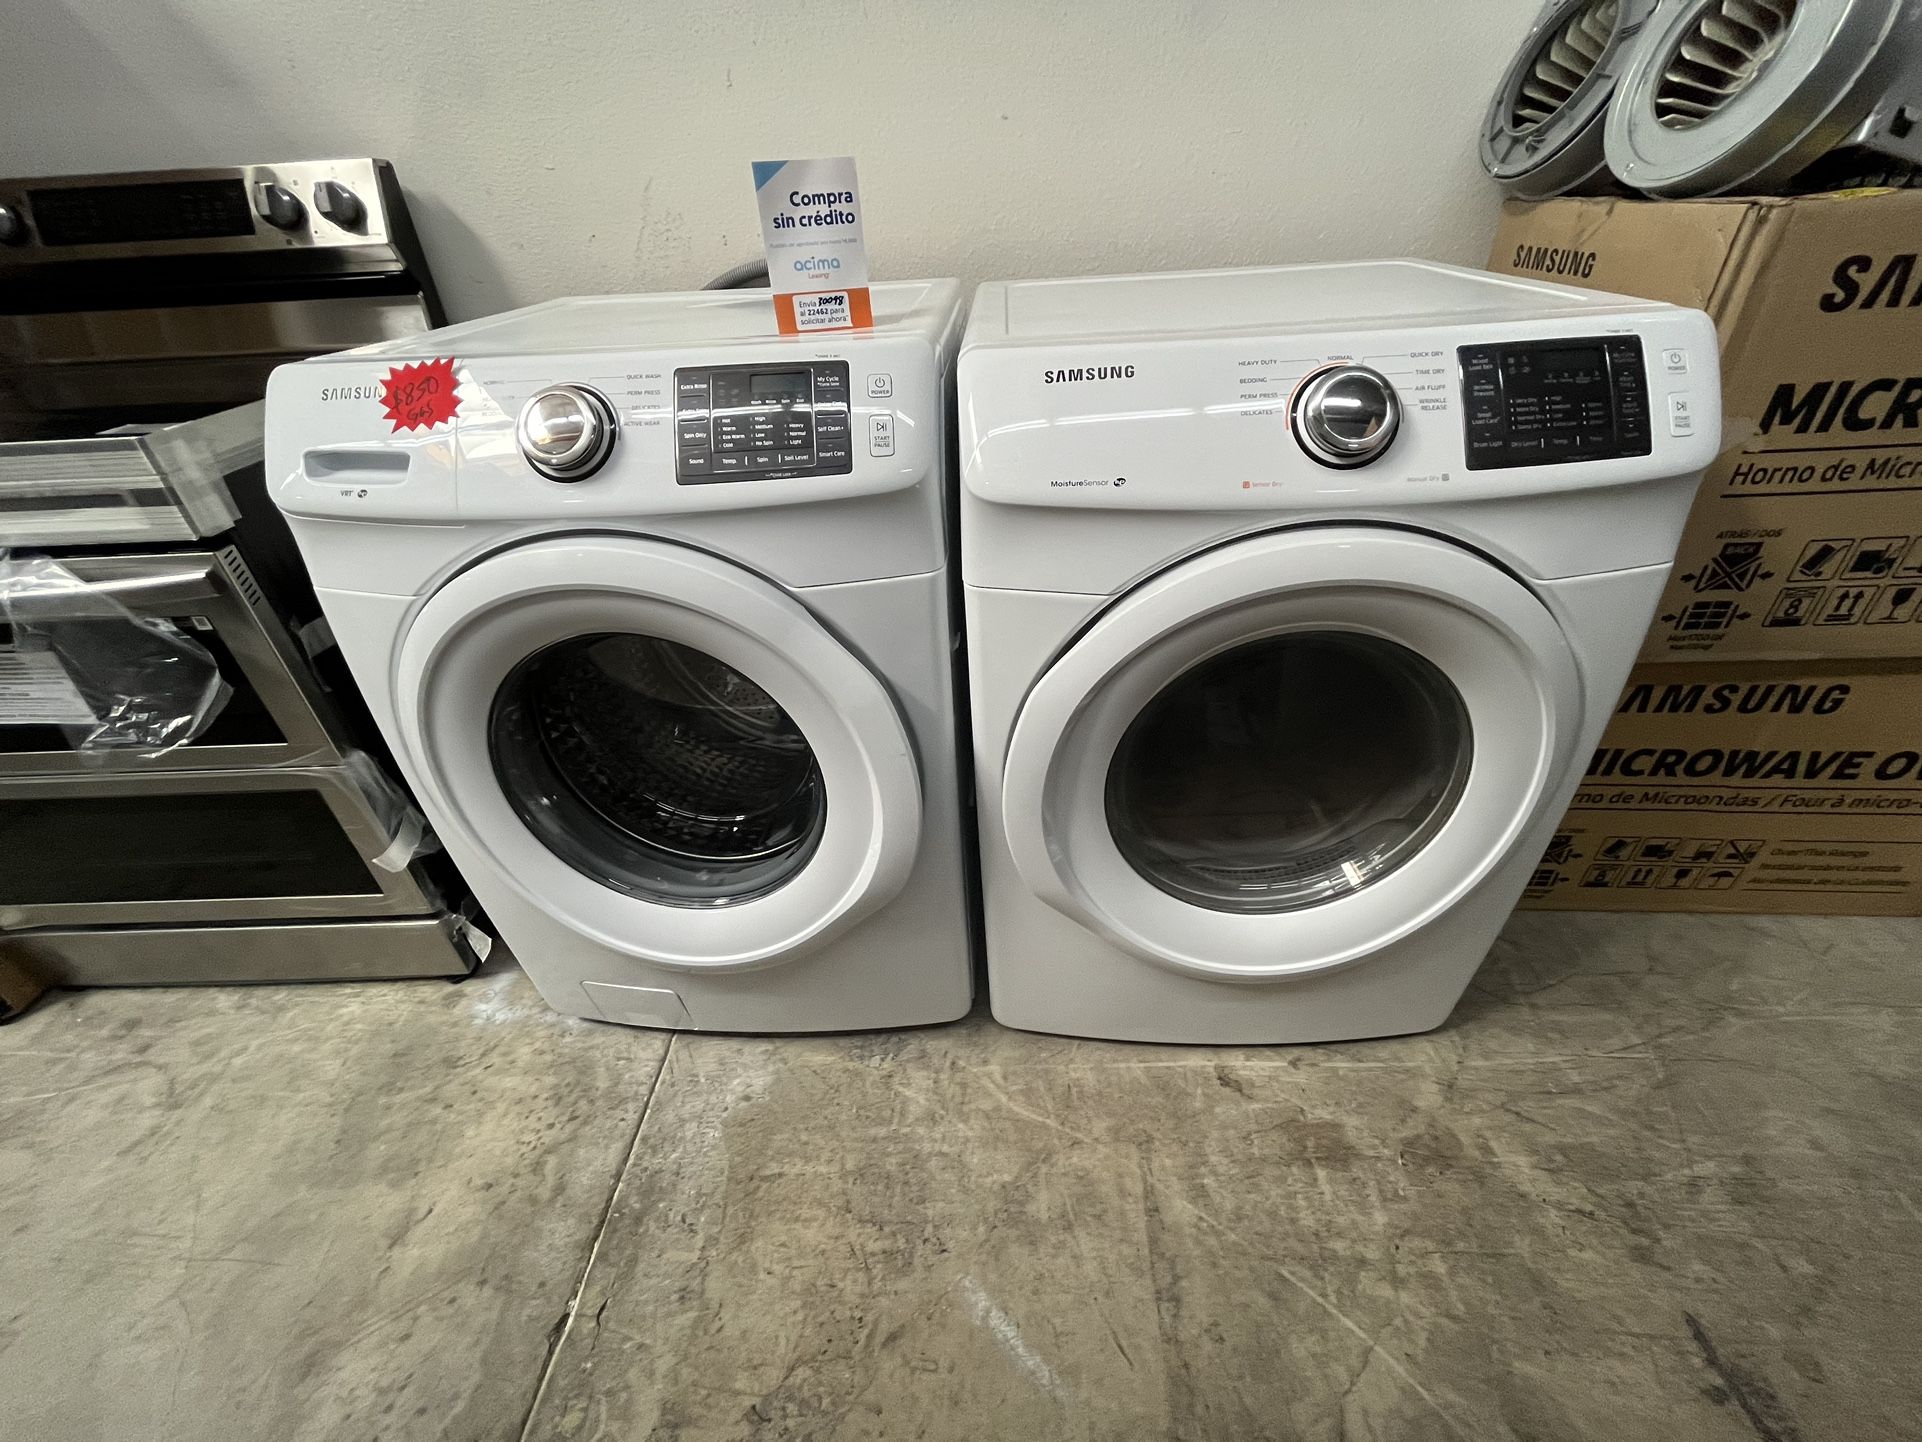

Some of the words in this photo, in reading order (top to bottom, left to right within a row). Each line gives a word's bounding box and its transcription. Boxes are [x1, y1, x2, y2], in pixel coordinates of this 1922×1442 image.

[789, 190, 853, 208] Compra
[772, 212, 796, 230] sin
[799, 209, 856, 228] crédito
[794, 256, 841, 272] acima
[1513, 244, 1596, 278] SAMSUNG
[801, 317, 826, 325] solicitar
[807, 308, 829, 316] 22462
[830, 308, 845, 316] para
[1044, 365, 1136, 384] SAMSUNG
[321, 386, 383, 402] SAMSUN
[1759, 377, 1922, 435] MICR
[695, 431, 708, 439] Only
[756, 456, 769, 464] Spin
[1728, 463, 1816, 487] Horno
[1820, 459, 1856, 483] de
[1859, 455, 1922, 481] Micr
[1050, 479, 1109, 488] MoistureSensor
[1784, 597, 1804, 617] 8
[1617, 683, 1851, 715] AMSUNG
[1874, 750, 1922, 781] O
[1572, 793, 1603, 804] rno
[1608, 790, 1634, 804] de
[1637, 791, 1762, 808] Microondas
[1779, 794, 1830, 808] Four
[1848, 795, 1922, 809] micro-
